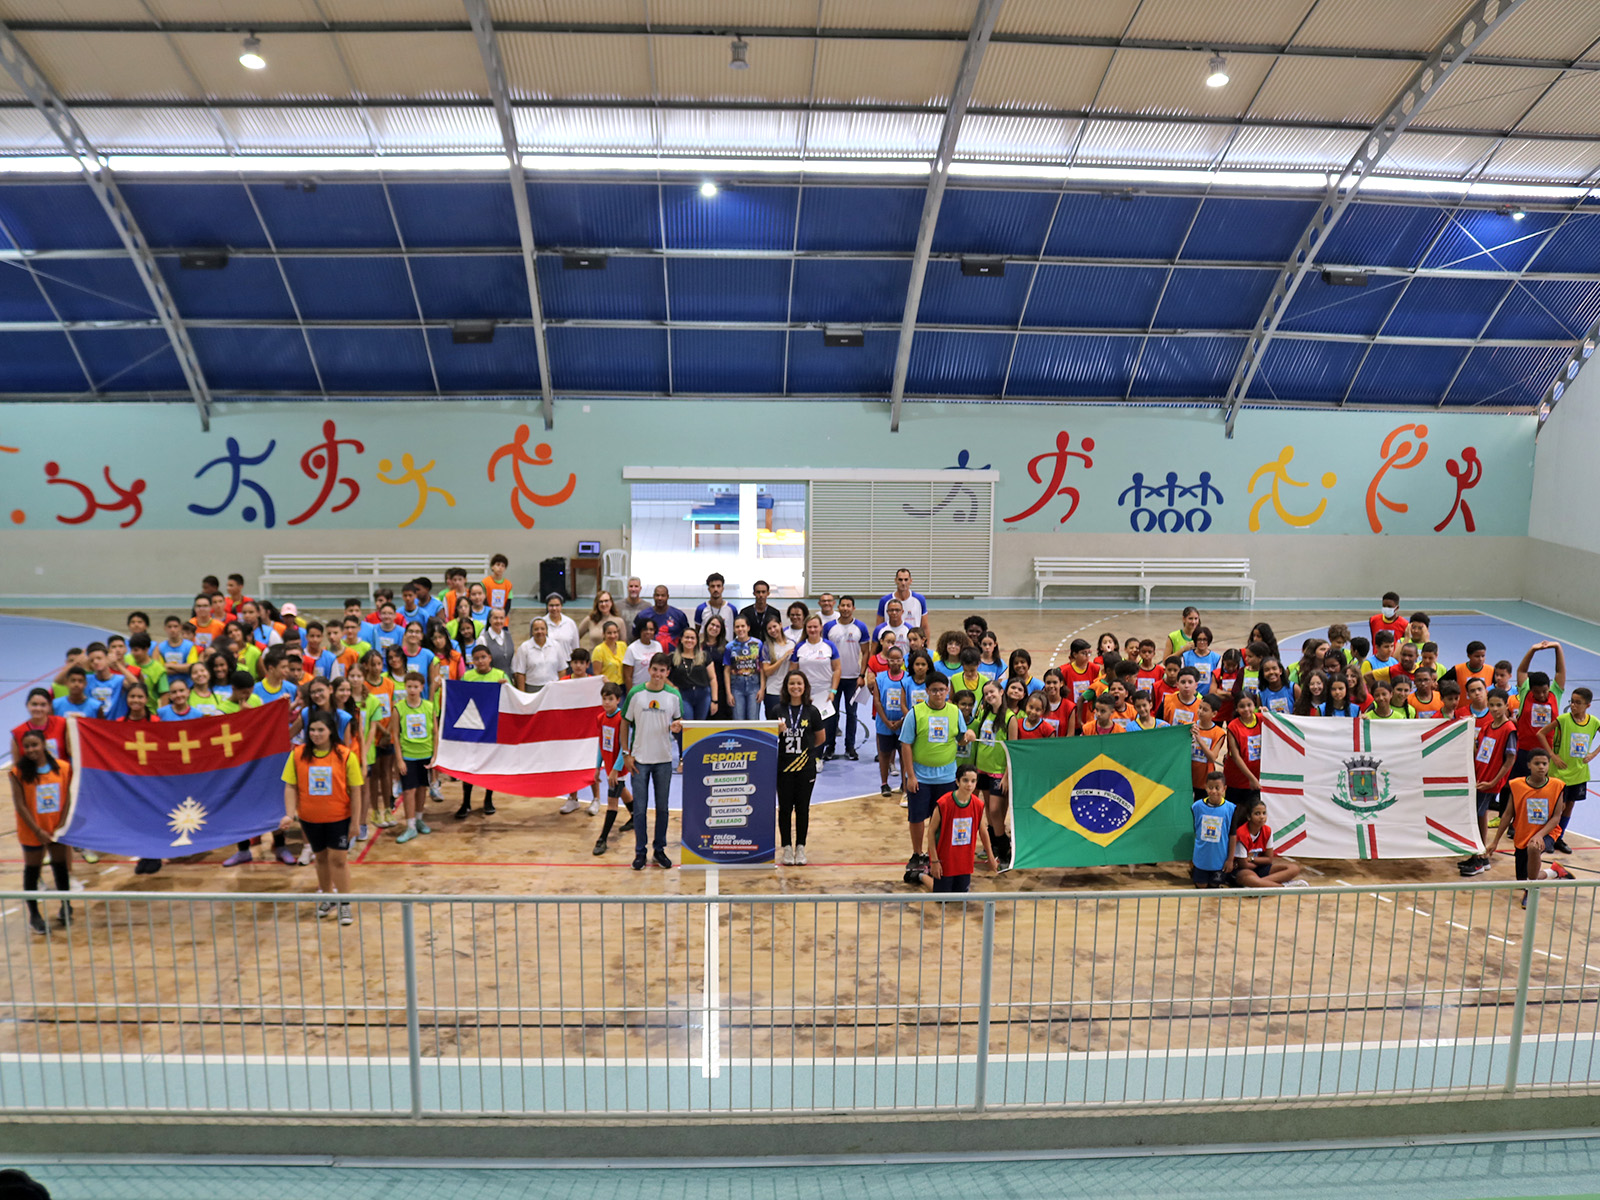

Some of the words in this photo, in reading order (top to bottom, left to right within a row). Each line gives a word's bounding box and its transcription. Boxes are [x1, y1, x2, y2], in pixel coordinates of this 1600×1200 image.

[785, 737, 802, 754] 21
[702, 751, 758, 764] ESPORTE
[721, 761, 745, 769] VIDA!
[1104, 791, 1131, 809] PROGRESSO
